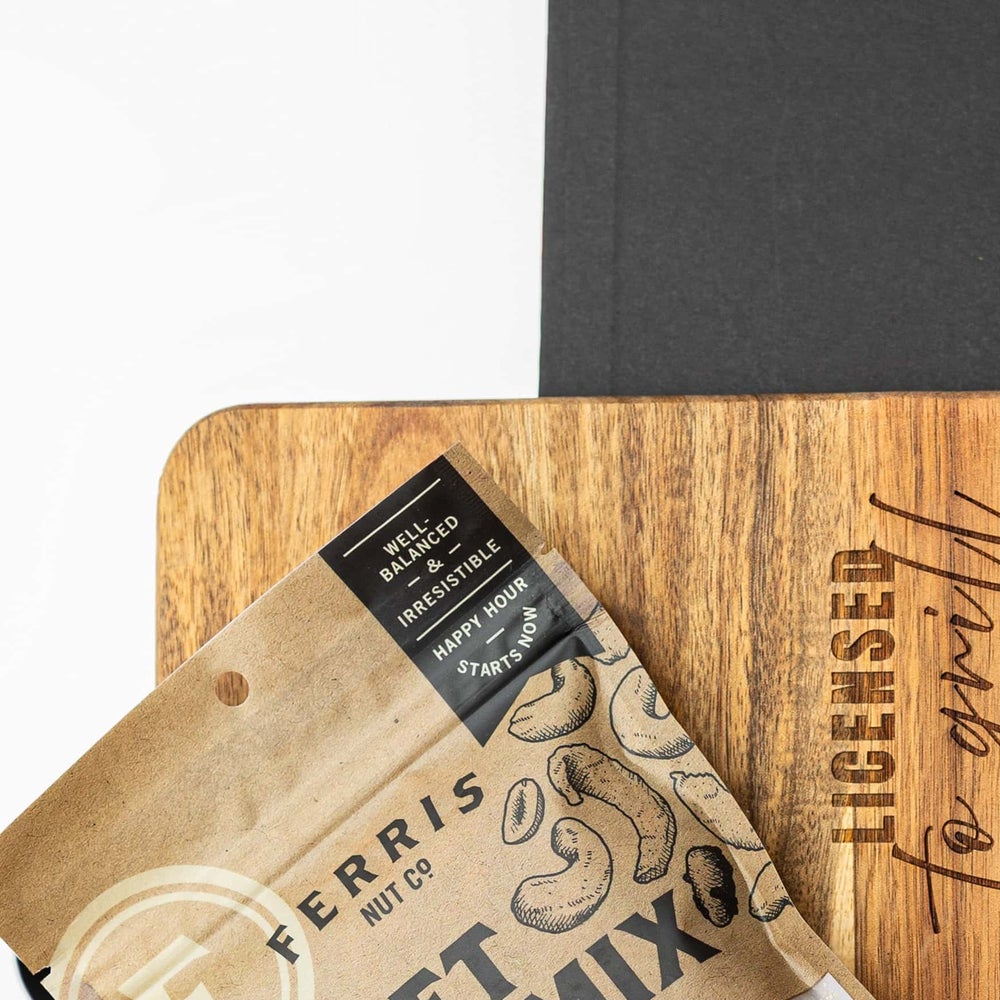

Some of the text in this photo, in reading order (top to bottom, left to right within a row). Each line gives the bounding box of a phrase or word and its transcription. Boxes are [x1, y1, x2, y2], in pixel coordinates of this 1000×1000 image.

[379, 515, 459, 582] BALANCED
[383, 517, 430, 557] WELL-
[426, 558, 445, 574] &
[397, 538, 501, 627] IRRESISTIBLE
[432, 577, 528, 661] HAPPY HOUR
[457, 606, 537, 677] STARTS NOW
[831, 549, 896, 844] LICENSED
[266, 772, 485, 965] FERRIS
[360, 884, 404, 927] NUT
